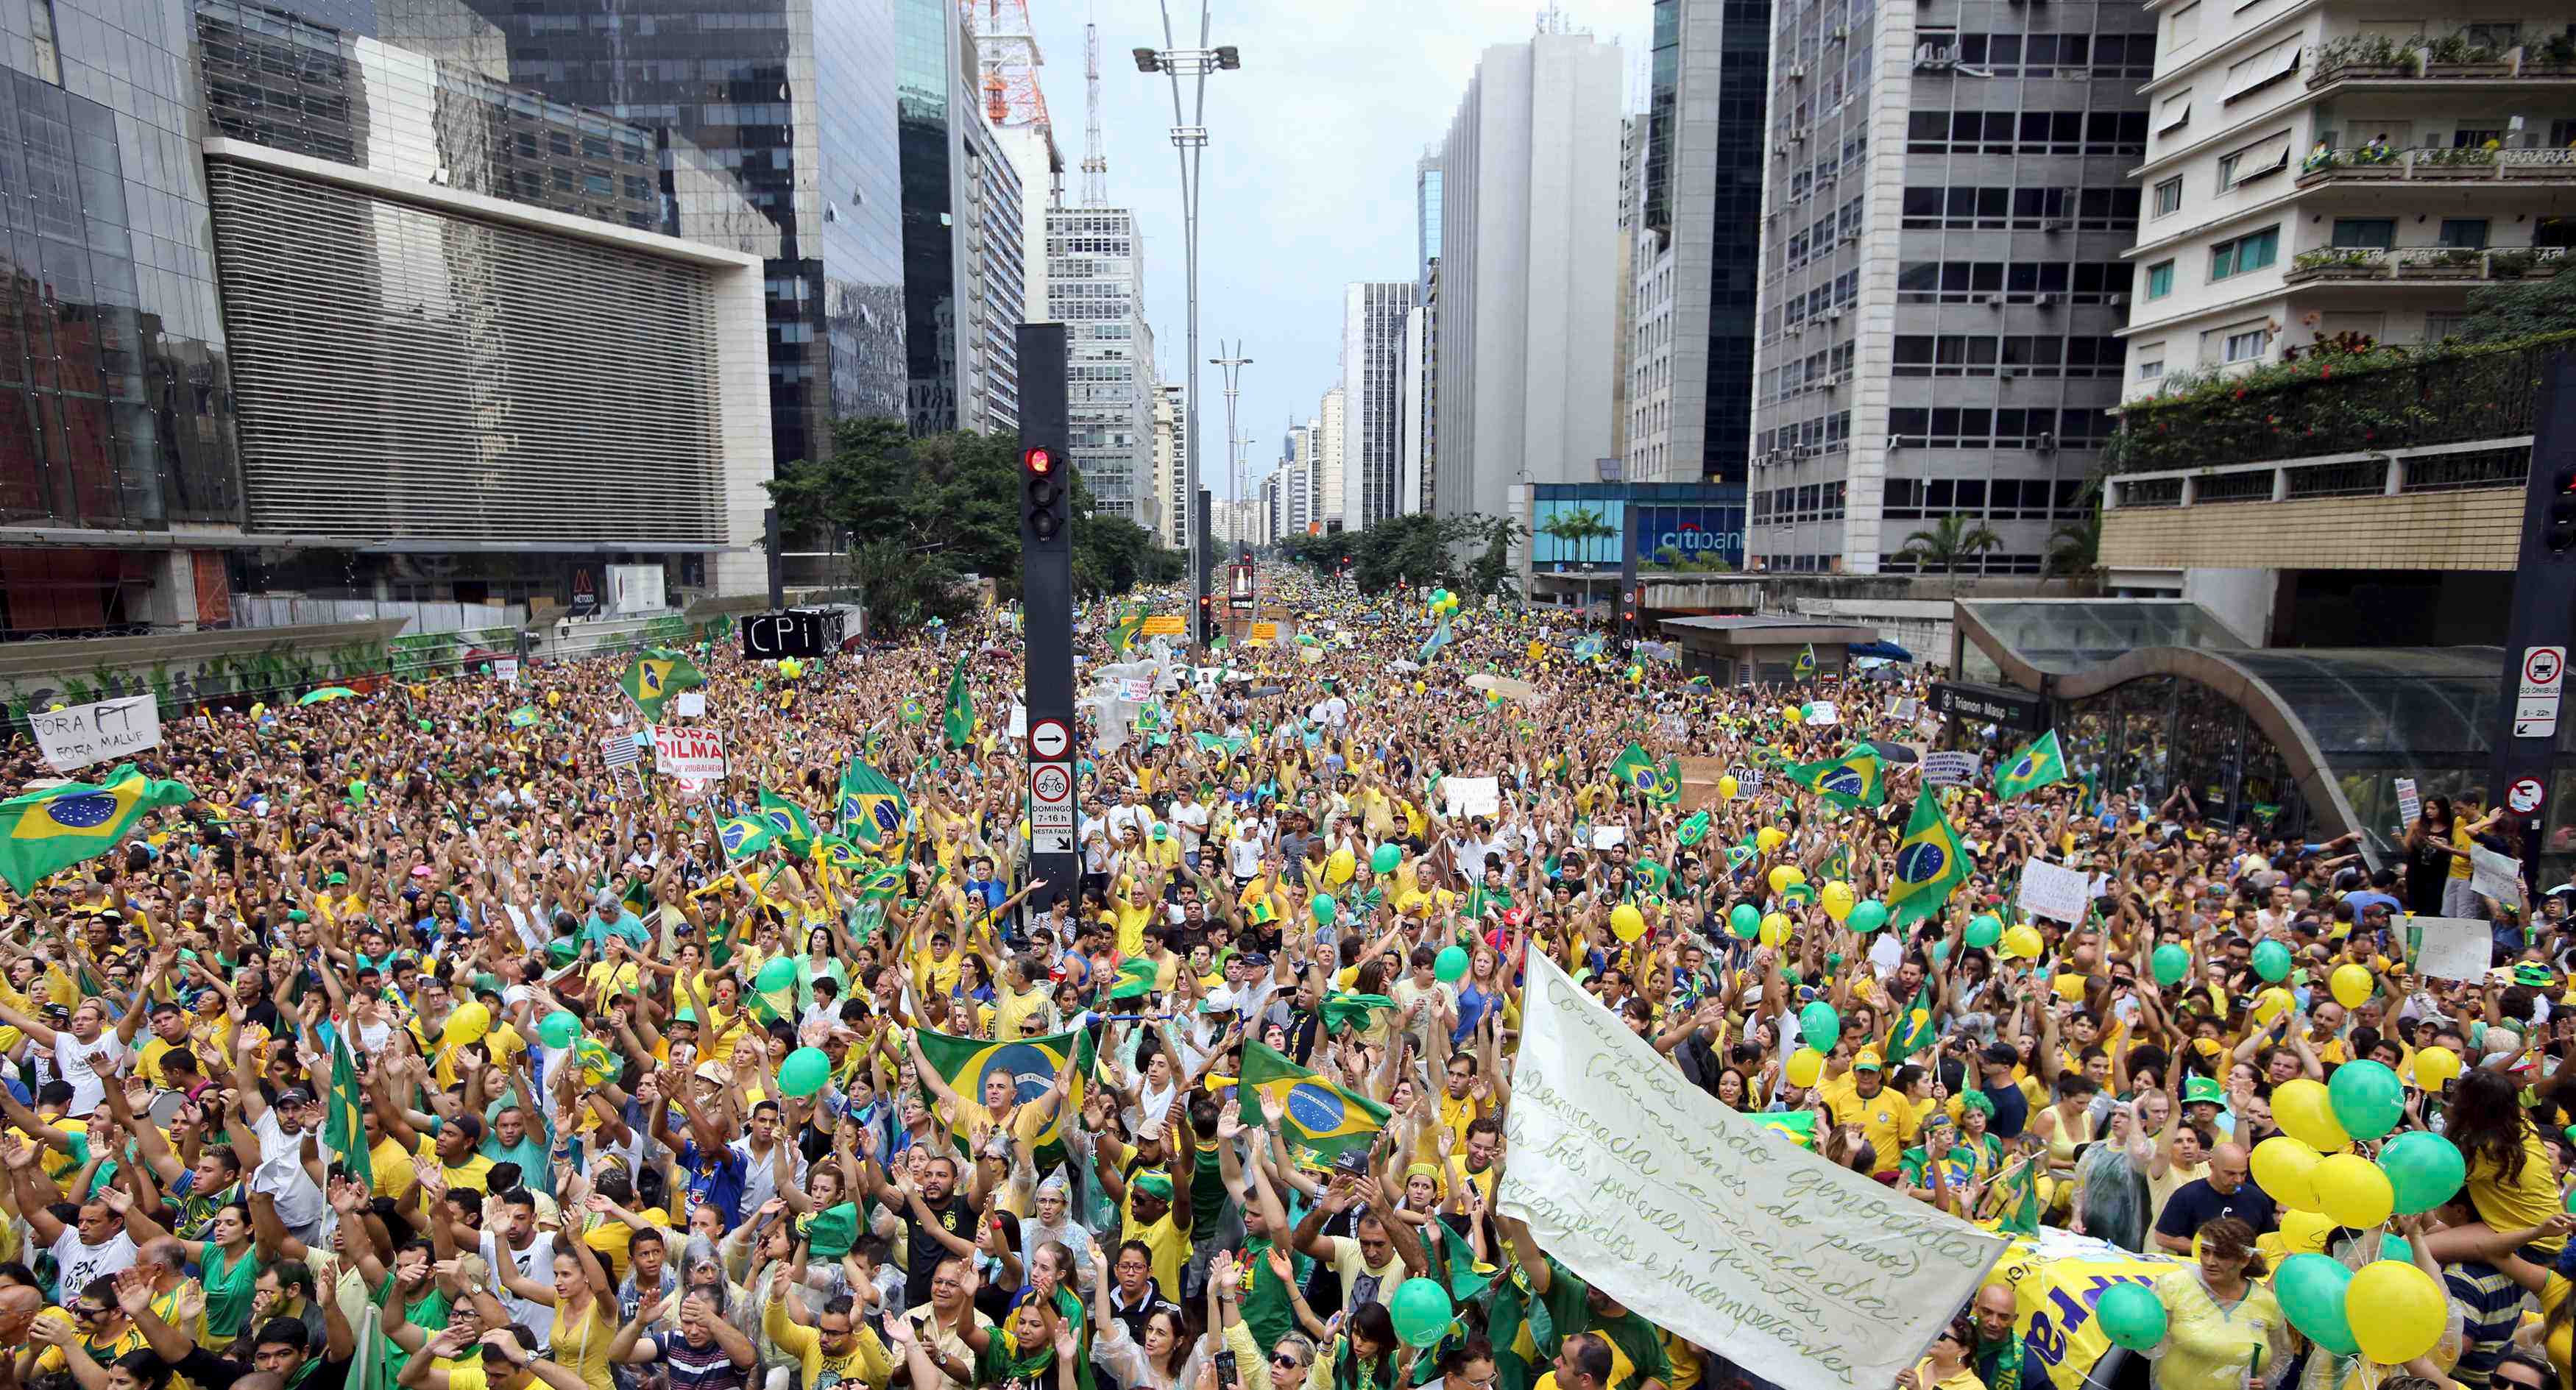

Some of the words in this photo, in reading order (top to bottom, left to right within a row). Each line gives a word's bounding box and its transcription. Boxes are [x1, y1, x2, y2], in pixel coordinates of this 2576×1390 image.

[574, 593, 595, 603] MÉTODO
[33, 715, 86, 736] FORA
[94, 703, 139, 734] PT
[1955, 696, 1981, 714] Trianon
[1984, 702, 2006, 720] Masp
[56, 743, 94, 761] FORA
[101, 731, 145, 749] MALUF
[654, 726, 721, 743] FORA
[656, 740, 724, 759] DILMA
[1755, 1200, 1812, 1228] do
